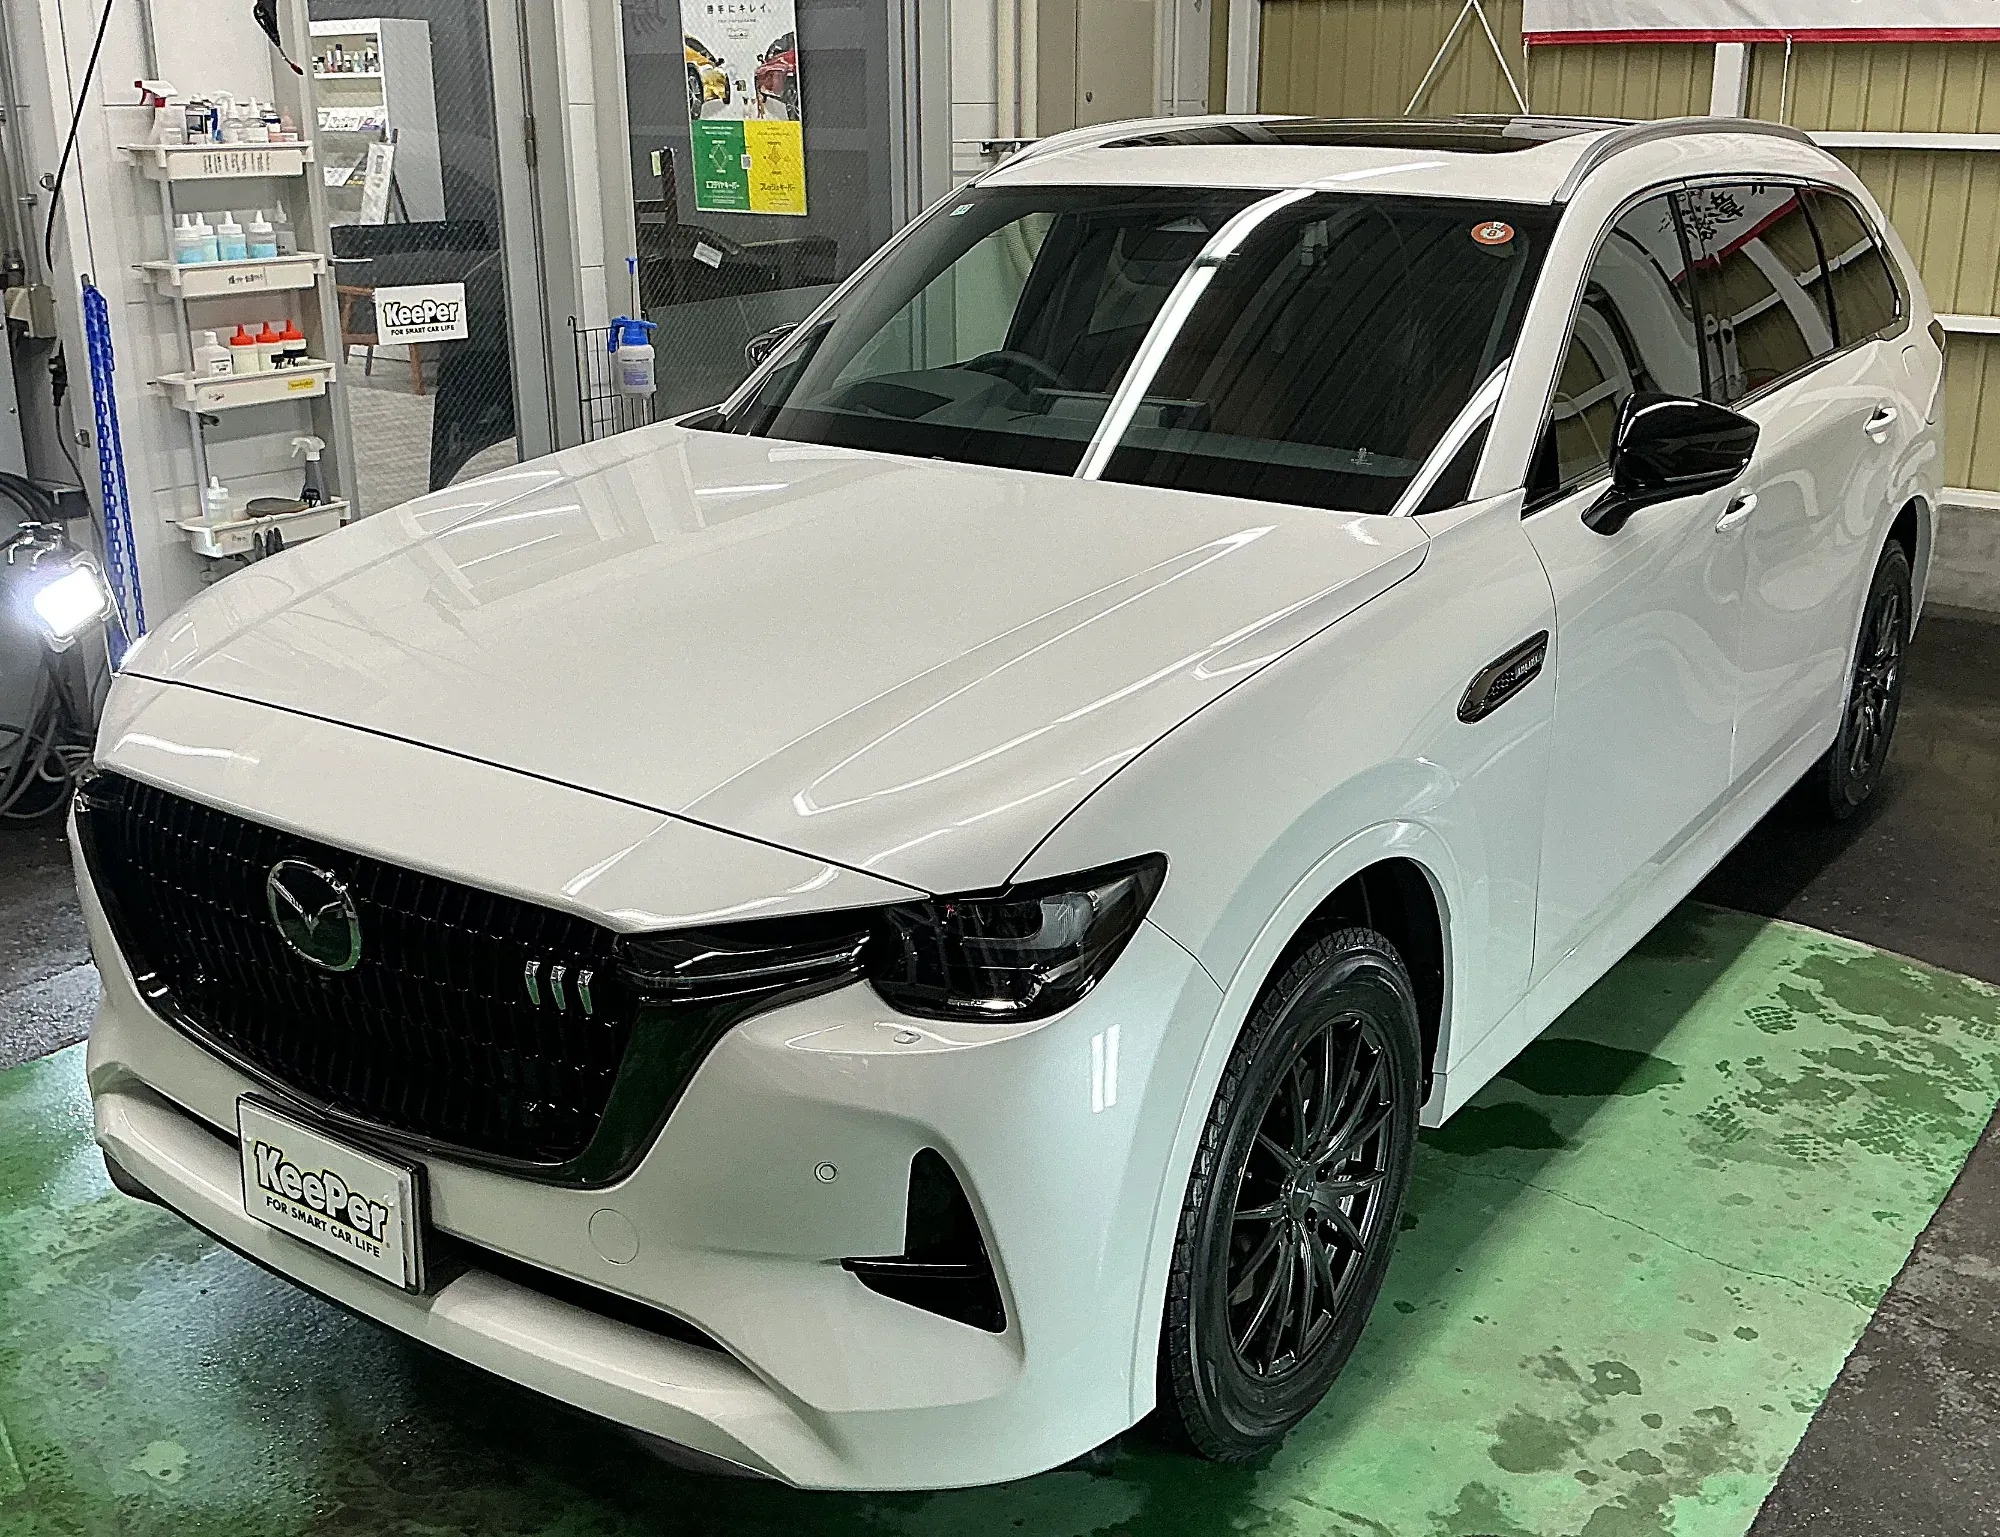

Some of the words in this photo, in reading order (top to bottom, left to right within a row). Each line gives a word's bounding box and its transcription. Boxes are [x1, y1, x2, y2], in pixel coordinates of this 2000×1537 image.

[383, 299, 459, 327] KeePer
[405, 326, 426, 335] SMART
[427, 325, 440, 333] CAR
[441, 324, 455, 332] LIFE
[254, 1140, 388, 1243] KeePer
[266, 1195, 288, 1215] FOR
[291, 1206, 328, 1232] SMART
[330, 1225, 353, 1244] CAR
[355, 1236, 381, 1259] LIFE
